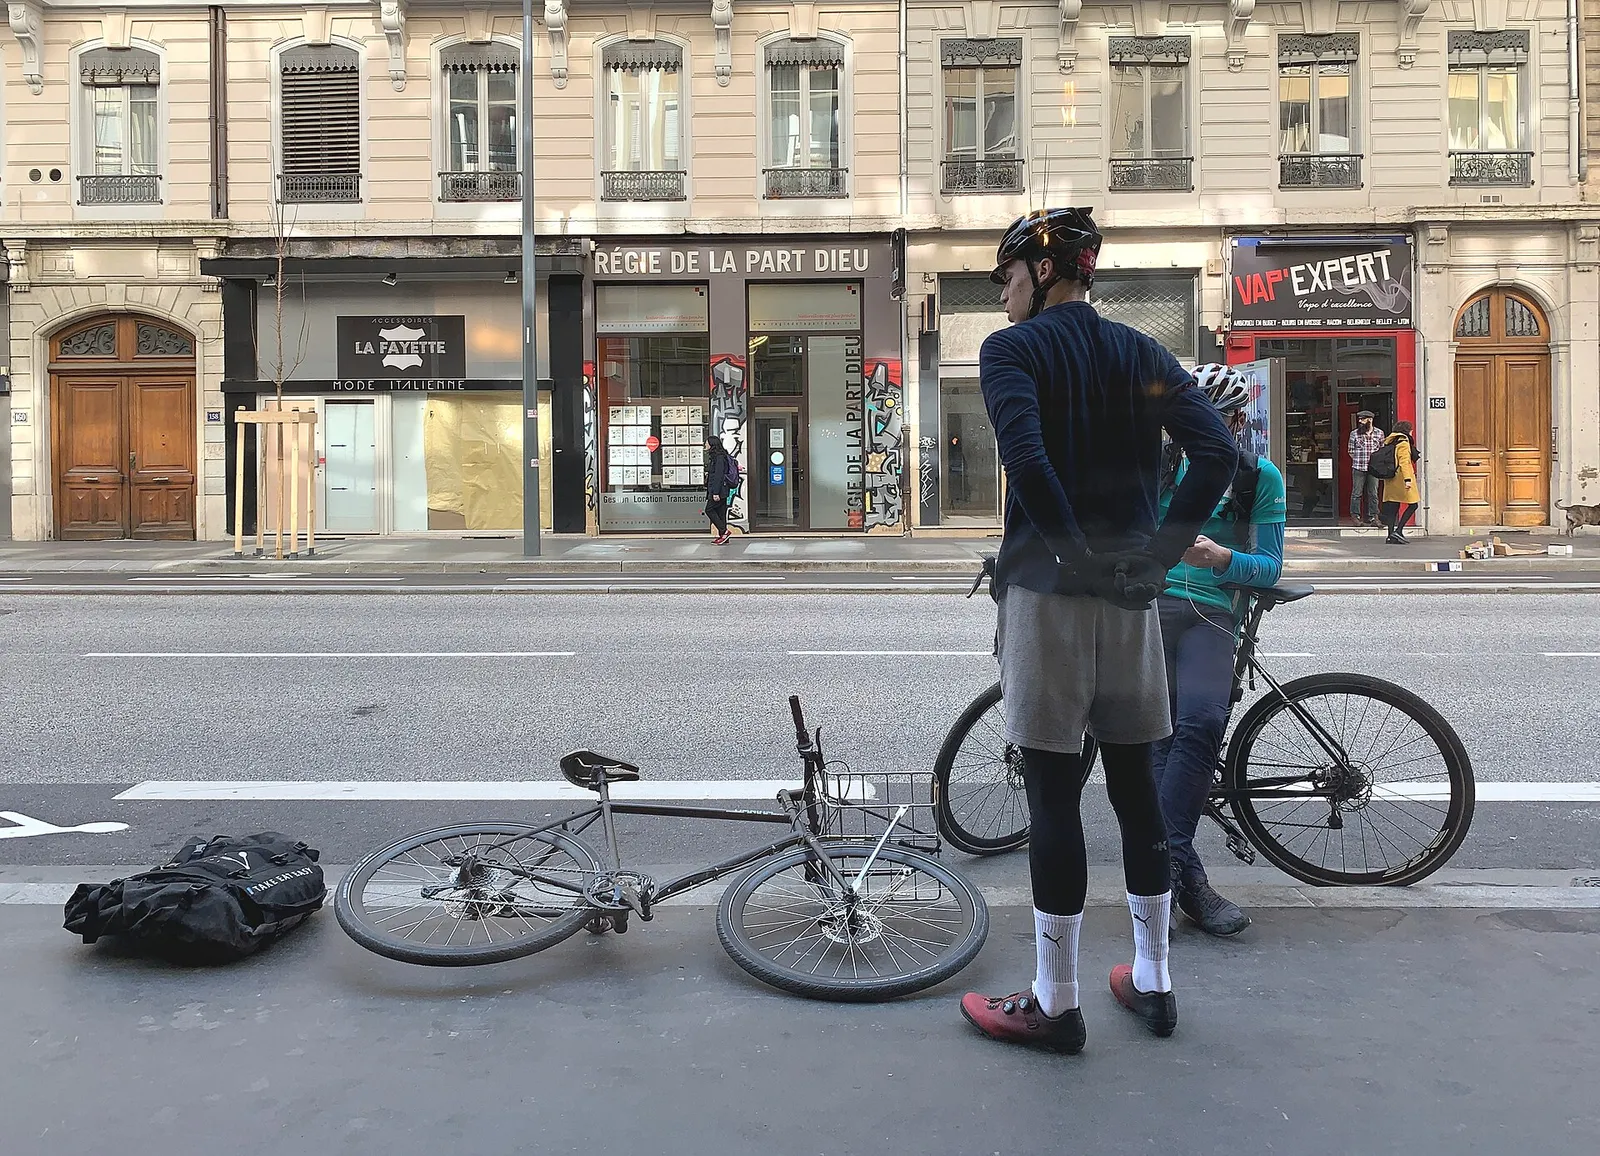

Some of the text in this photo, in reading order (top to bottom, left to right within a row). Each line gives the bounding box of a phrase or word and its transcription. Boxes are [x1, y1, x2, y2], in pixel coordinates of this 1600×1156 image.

[594, 246, 870, 274] RÉGIE DE LA PART DIEU
[1234, 249, 1392, 306] VAP' EXPERT
[1297, 299, 1374, 312] Vape d'excellence
[355, 341, 446, 354] LA FAYETTE
[333, 381, 465, 390] MODE ITALIENNE
[1430, 398, 1445, 408] 156
[844, 336, 862, 528] RÉGIE DE LA PART DIEU
[633, 495, 663, 503] Location
[667, 495, 707, 503] Transaction
[252, 867, 313, 892] TAKE EAT EASY
